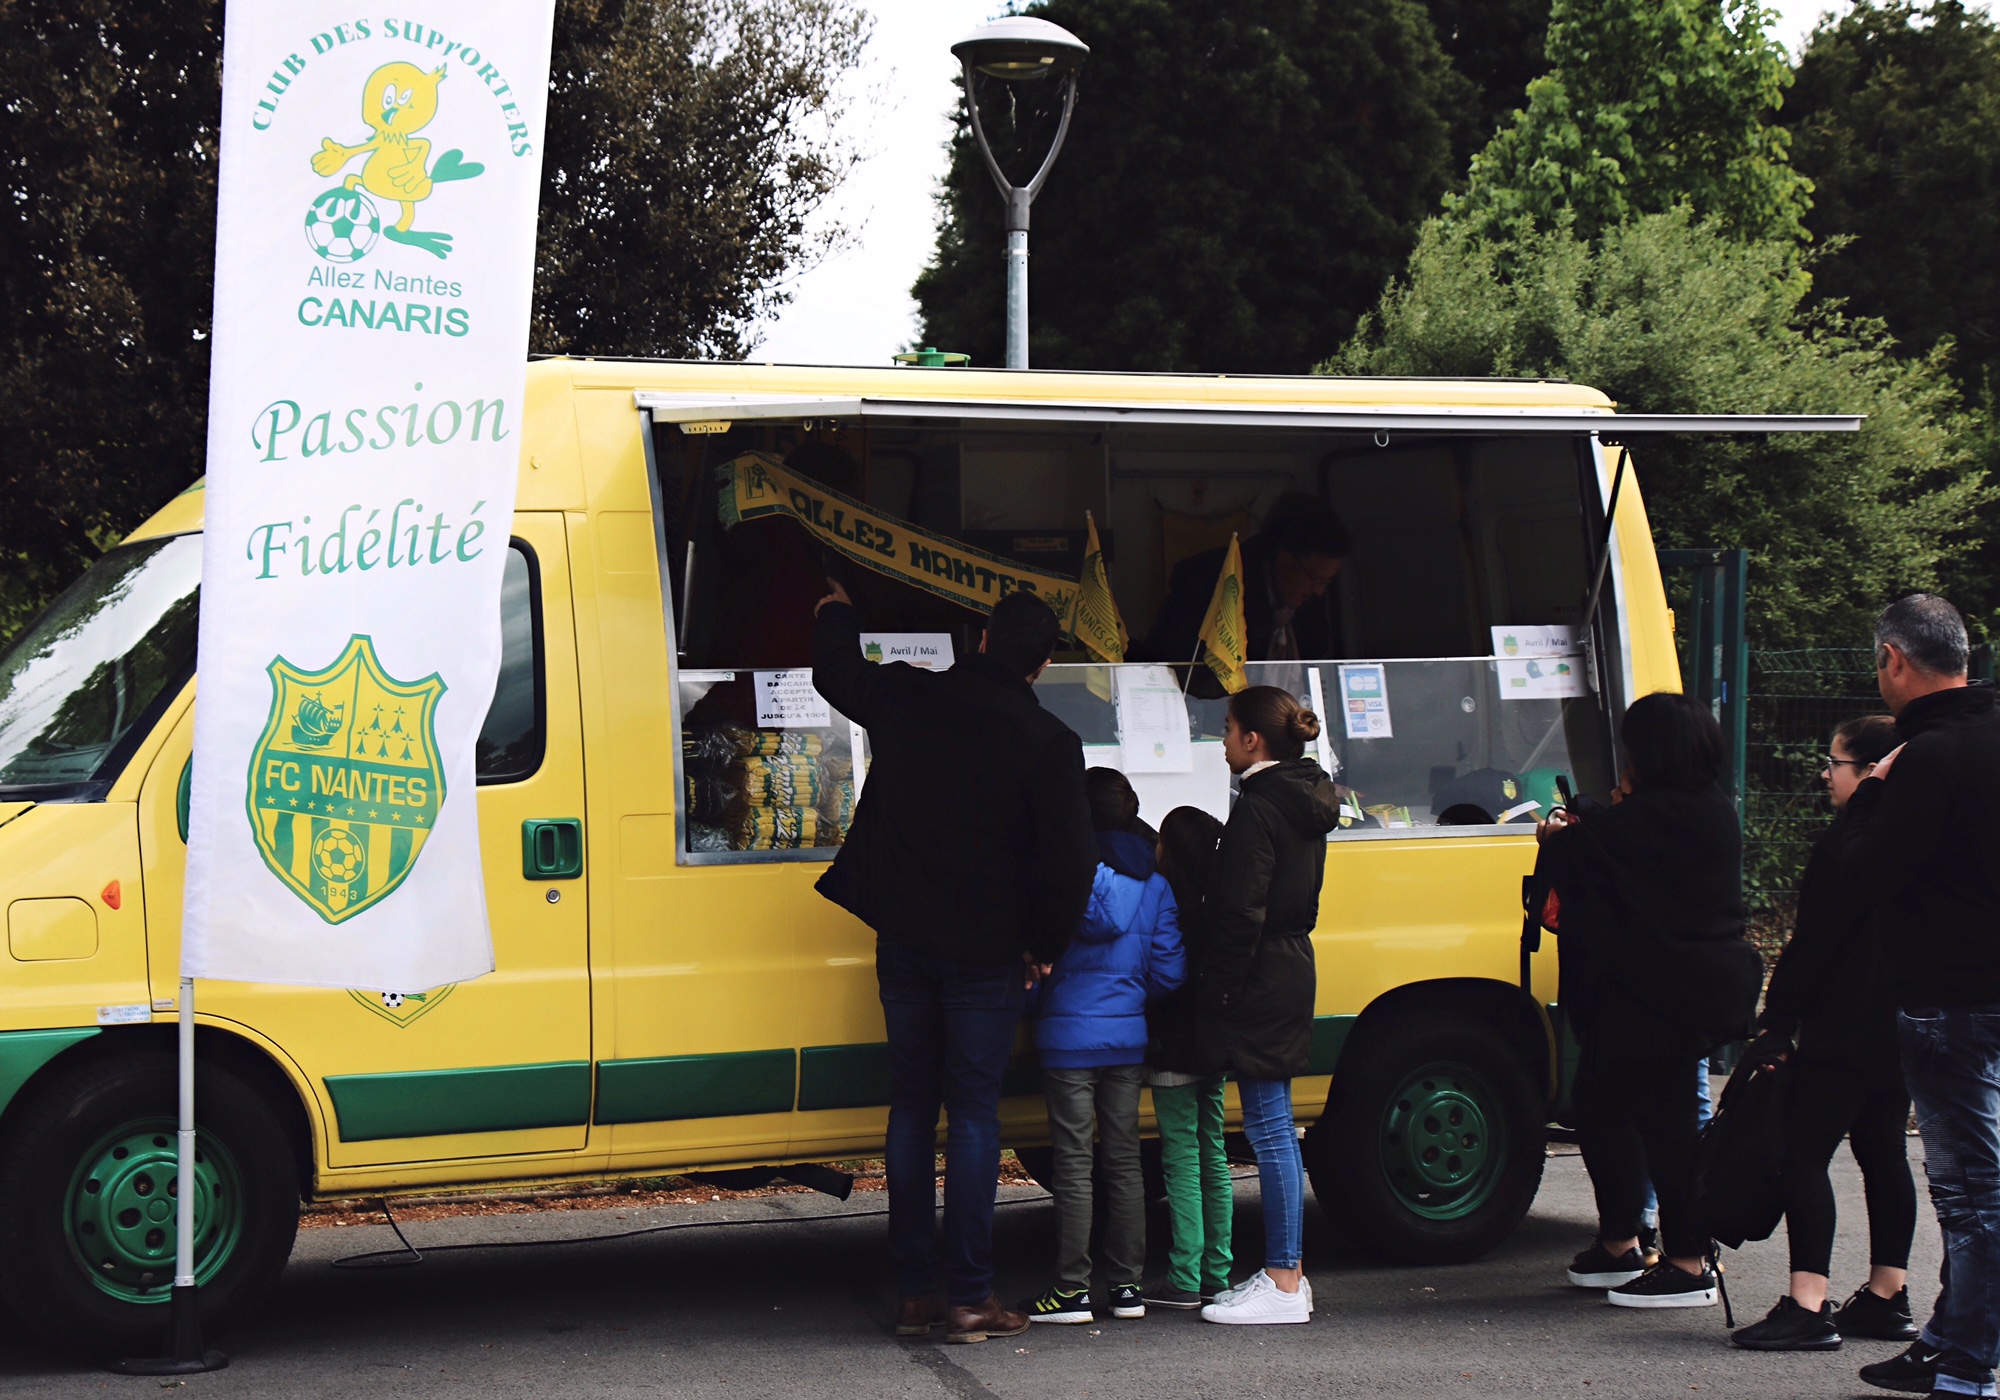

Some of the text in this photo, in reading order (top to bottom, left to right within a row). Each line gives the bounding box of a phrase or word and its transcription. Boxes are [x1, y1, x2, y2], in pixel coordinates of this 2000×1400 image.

[253, 17, 533, 157] CLUB DES SUPPORTERS
[307, 266, 463, 297] Allez Nantes
[298, 296, 470, 337] CANARIS
[251, 381, 510, 463] Passion
[246, 498, 489, 580] Fidélité
[890, 646, 911, 655] Avril
[920, 646, 938, 655] Mai
[1525, 638, 1543, 646] Avril
[1551, 638, 1568, 646] Mai
[264, 759, 427, 808] FC NANTES
[320, 885, 358, 901] 1943
